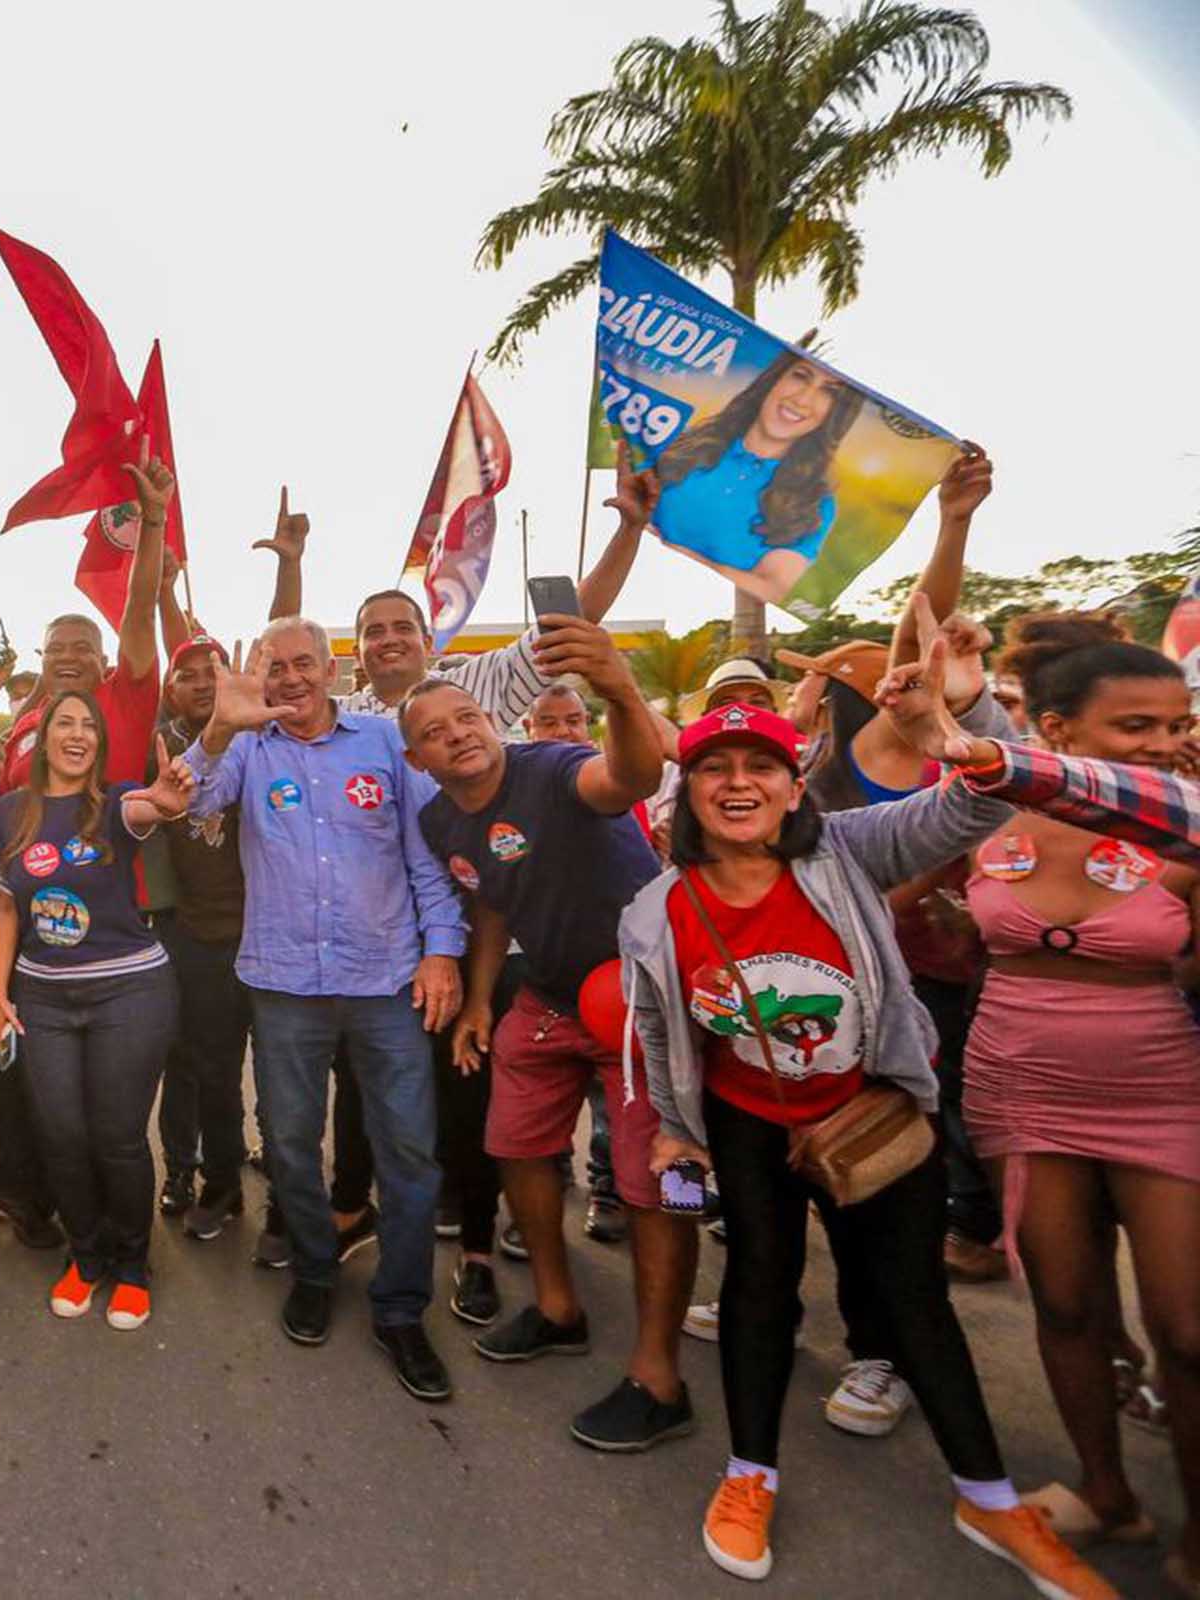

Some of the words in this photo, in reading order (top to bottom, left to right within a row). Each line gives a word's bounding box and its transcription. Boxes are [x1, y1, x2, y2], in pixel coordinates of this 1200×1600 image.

[600, 369, 681, 446] 789
[358, 786, 373, 799] 13
[738, 953, 811, 971] LHADORES
